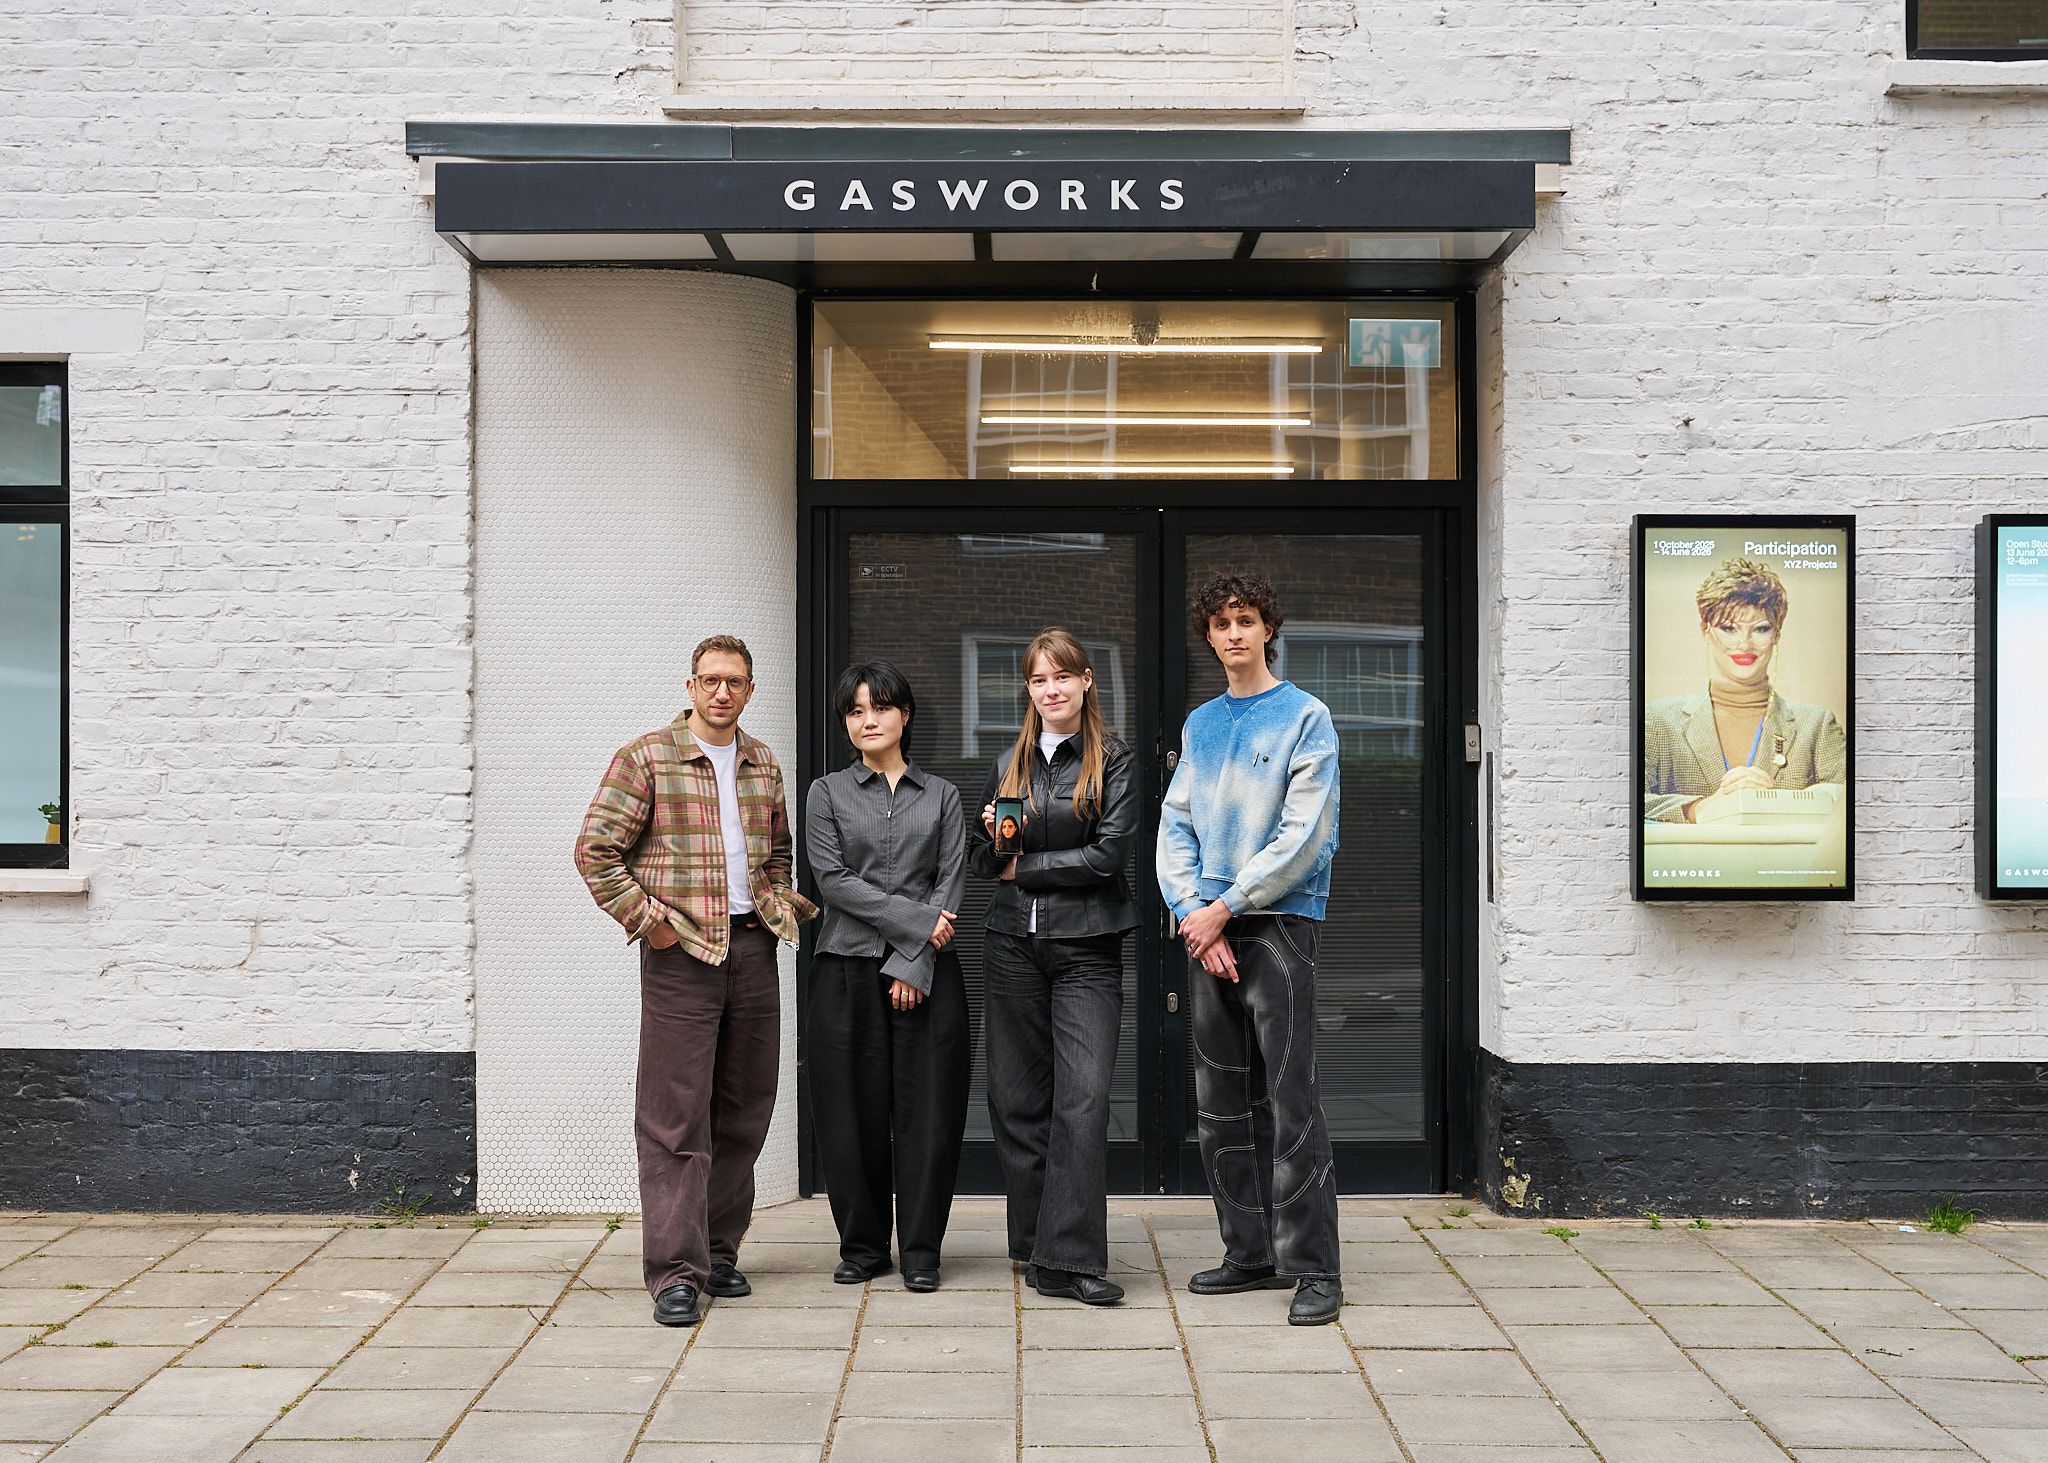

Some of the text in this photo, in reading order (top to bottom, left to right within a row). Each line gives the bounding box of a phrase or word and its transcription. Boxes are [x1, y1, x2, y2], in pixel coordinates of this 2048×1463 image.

[783, 179, 1185, 211] GASWORKS
[1653, 541, 1715, 549] 1 October 2025
[1744, 541, 1837, 557] Participation
[2006, 540, 2030, 549] Open
[1661, 548, 1670, 556] 14
[1671, 548, 1690, 556] June
[2006, 549, 2015, 557] 13
[2016, 549, 2035, 557] June
[1784, 560, 1838, 570] XYZ Projects
[1652, 869, 1721, 878] GASWORKS
